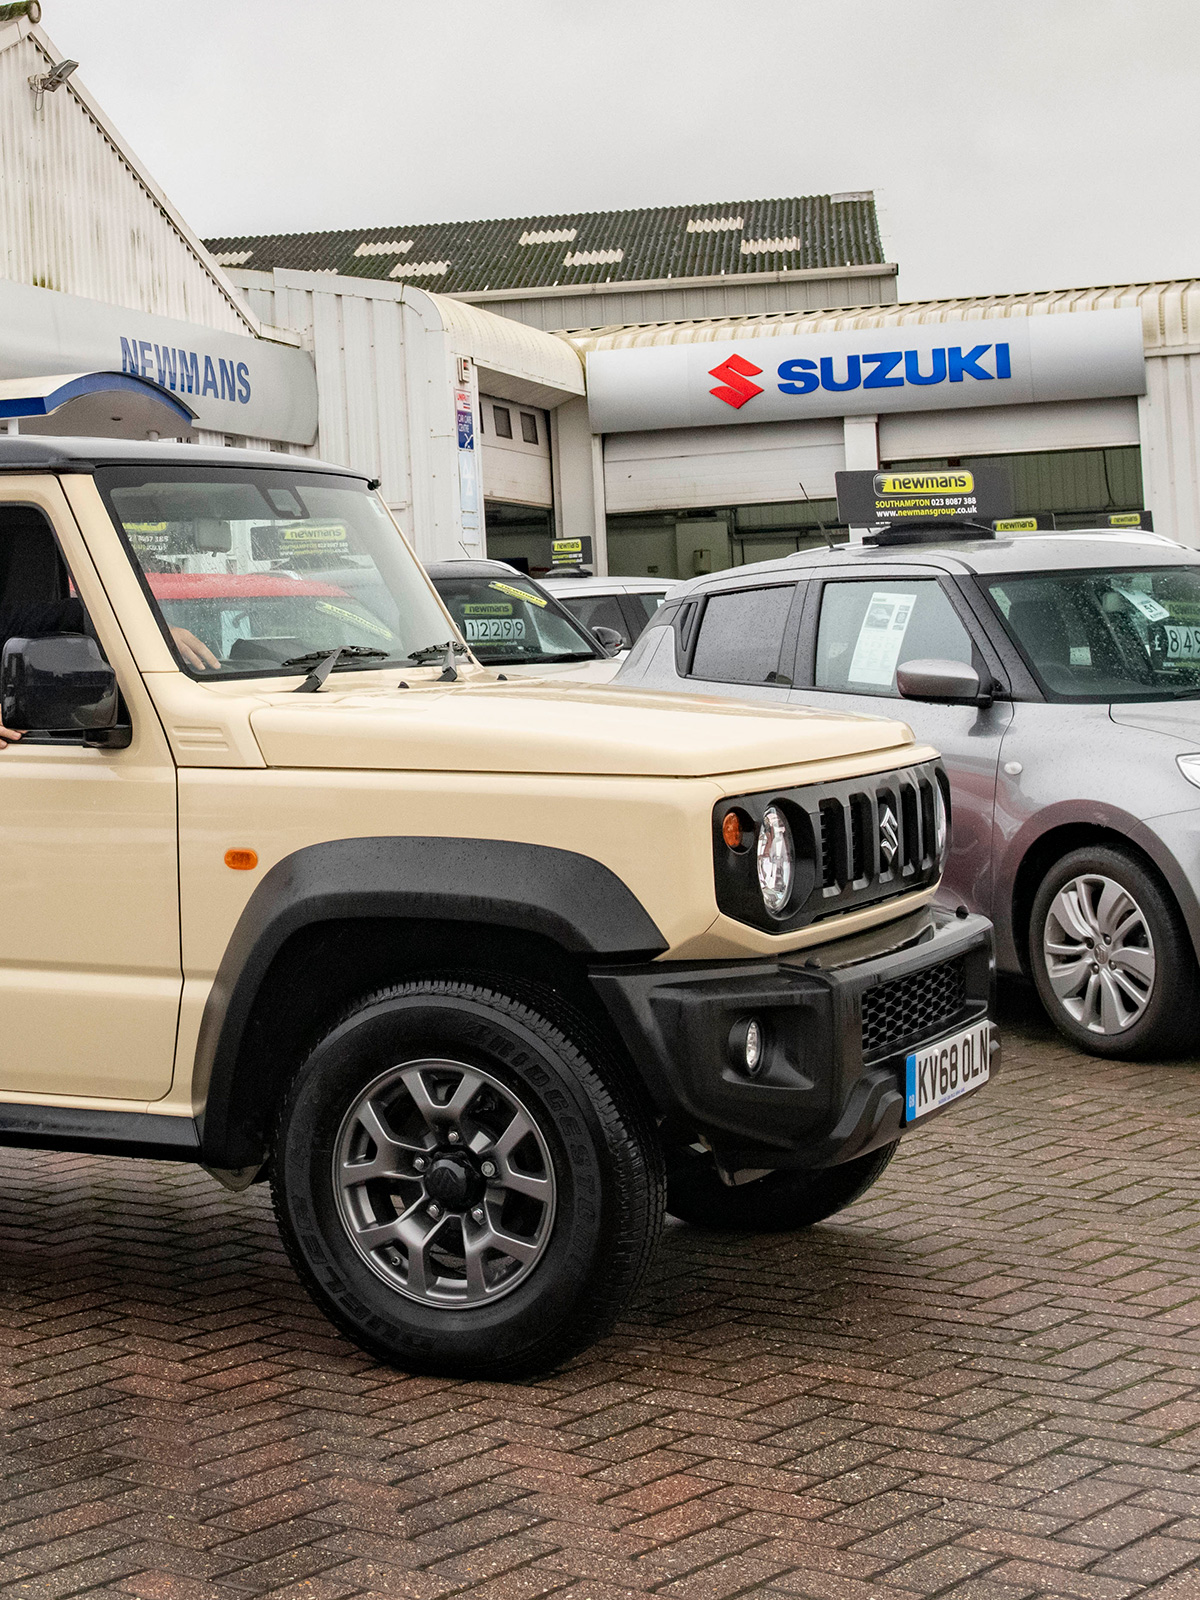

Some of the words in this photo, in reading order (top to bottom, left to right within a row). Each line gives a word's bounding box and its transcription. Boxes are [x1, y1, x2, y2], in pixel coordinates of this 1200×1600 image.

[119, 336, 251, 404] NEWMANS
[777, 342, 1012, 395] SUZUKI
[892, 475, 967, 490] newmans
[875, 498, 930, 509] SOUTHAMPTON
[931, 498, 945, 506] 023
[945, 497, 962, 505] 8087
[963, 497, 977, 505] 388
[876, 505, 978, 517] www.newmansgroup.co.uk
[1000, 519, 1034, 529] newmans
[1113, 515, 1138, 524] newmans
[290, 529, 342, 539] newmans
[557, 541, 580, 550] newmans
[469, 605, 510, 613] newmans
[468, 621, 524, 637] 12299
[918, 1043, 958, 1108] KV68
[962, 1026, 988, 1083] OLN
